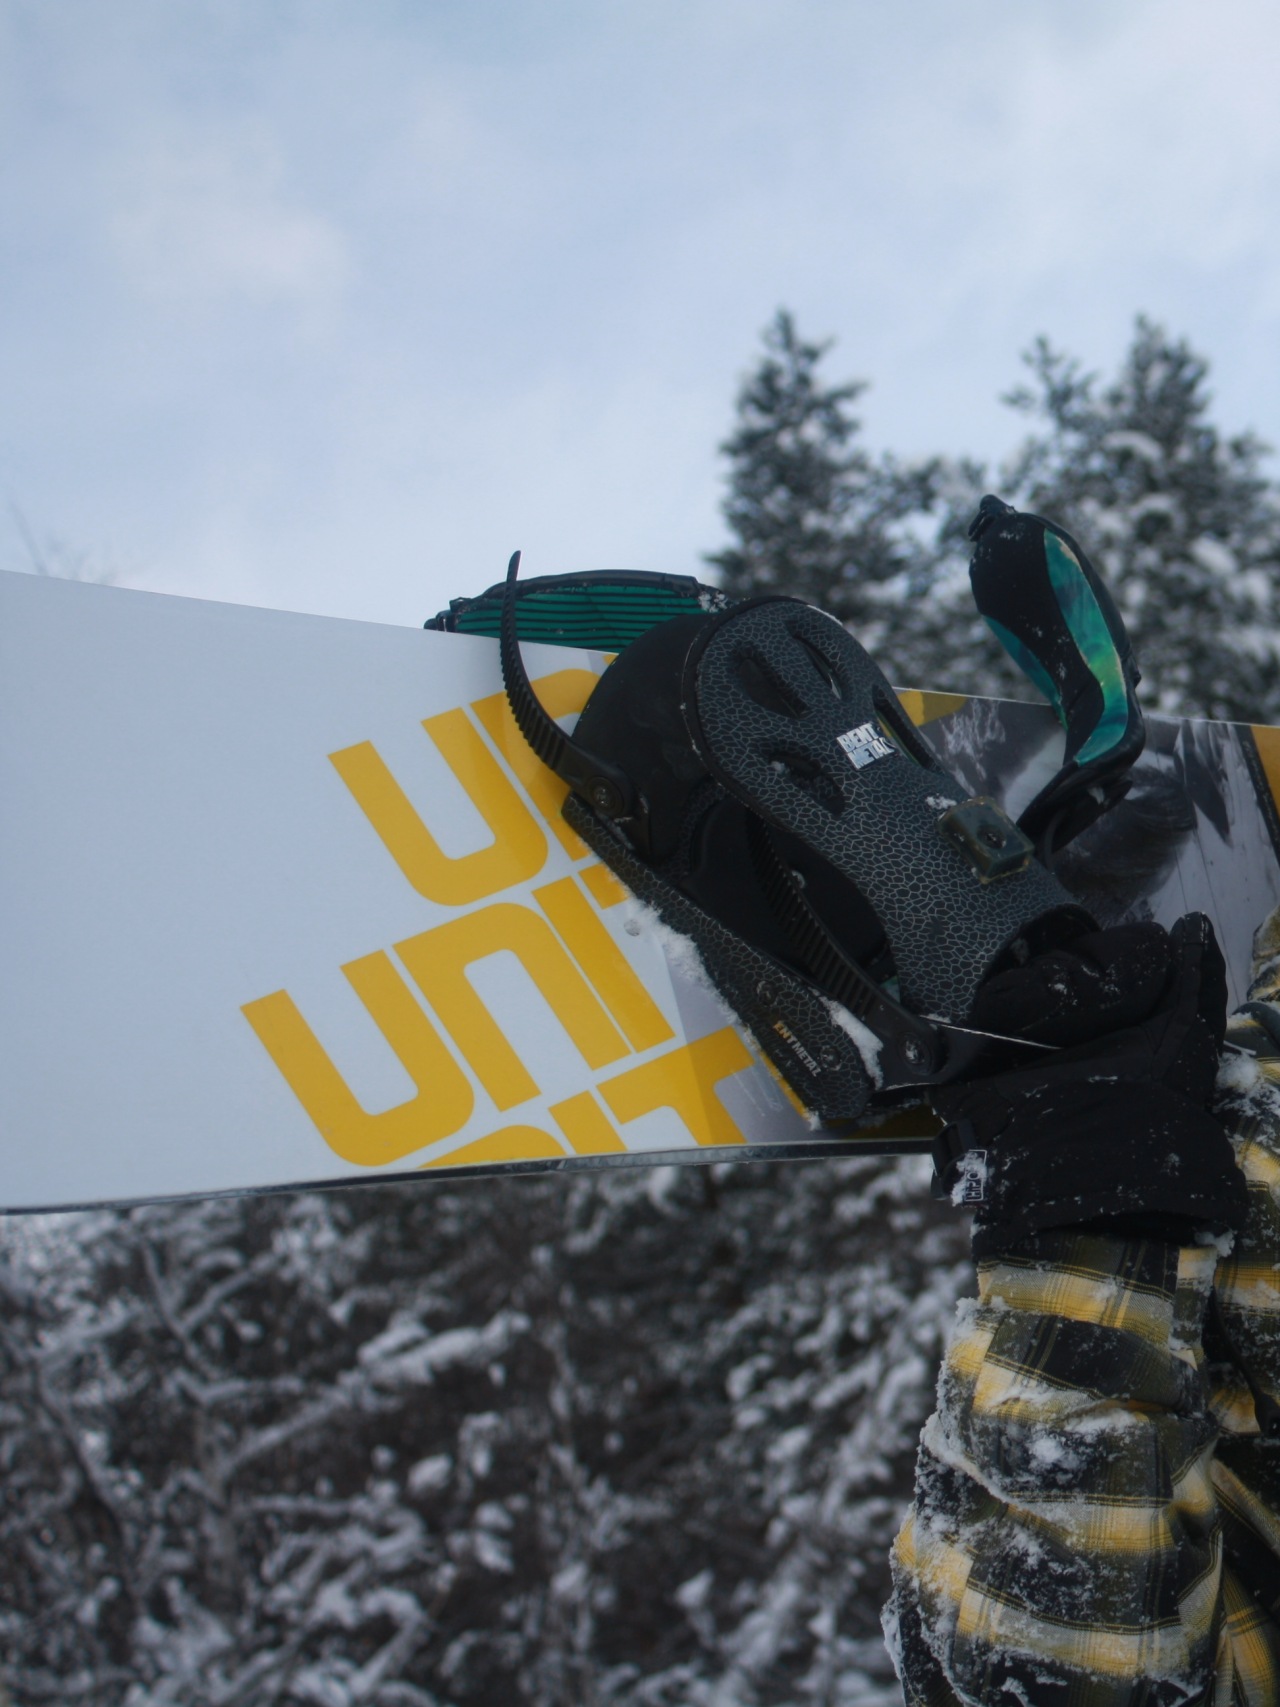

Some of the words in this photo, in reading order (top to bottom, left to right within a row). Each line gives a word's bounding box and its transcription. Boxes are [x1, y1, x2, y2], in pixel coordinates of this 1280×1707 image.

[836, 722, 880, 753] BENT
[772, 1020, 799, 1044] ENT
[791, 1041, 821, 1077] METAL
